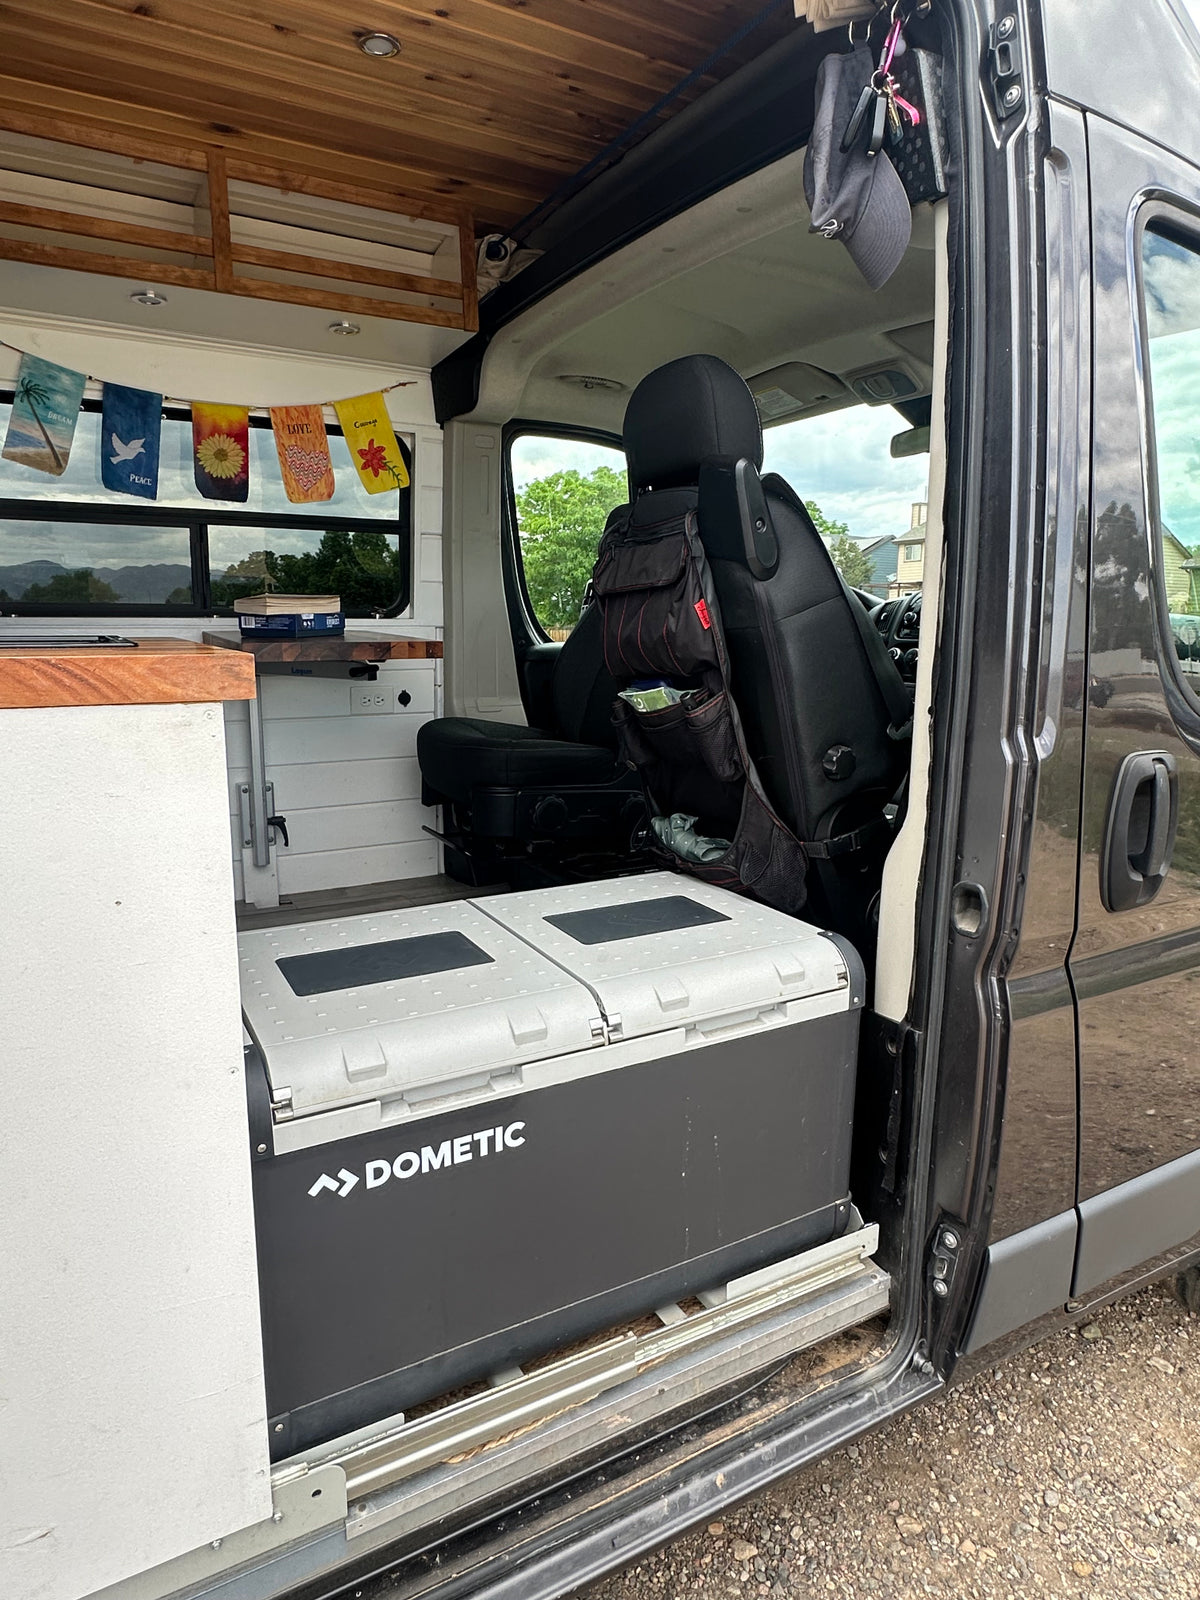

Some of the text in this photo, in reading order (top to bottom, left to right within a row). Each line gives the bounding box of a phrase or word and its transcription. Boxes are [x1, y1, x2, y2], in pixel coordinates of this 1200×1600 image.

[47, 411, 73, 425] DREAM
[287, 423, 312, 435] LOVE
[130, 473, 153, 486] PEACE
[365, 1121, 526, 1189] DOMETIC
